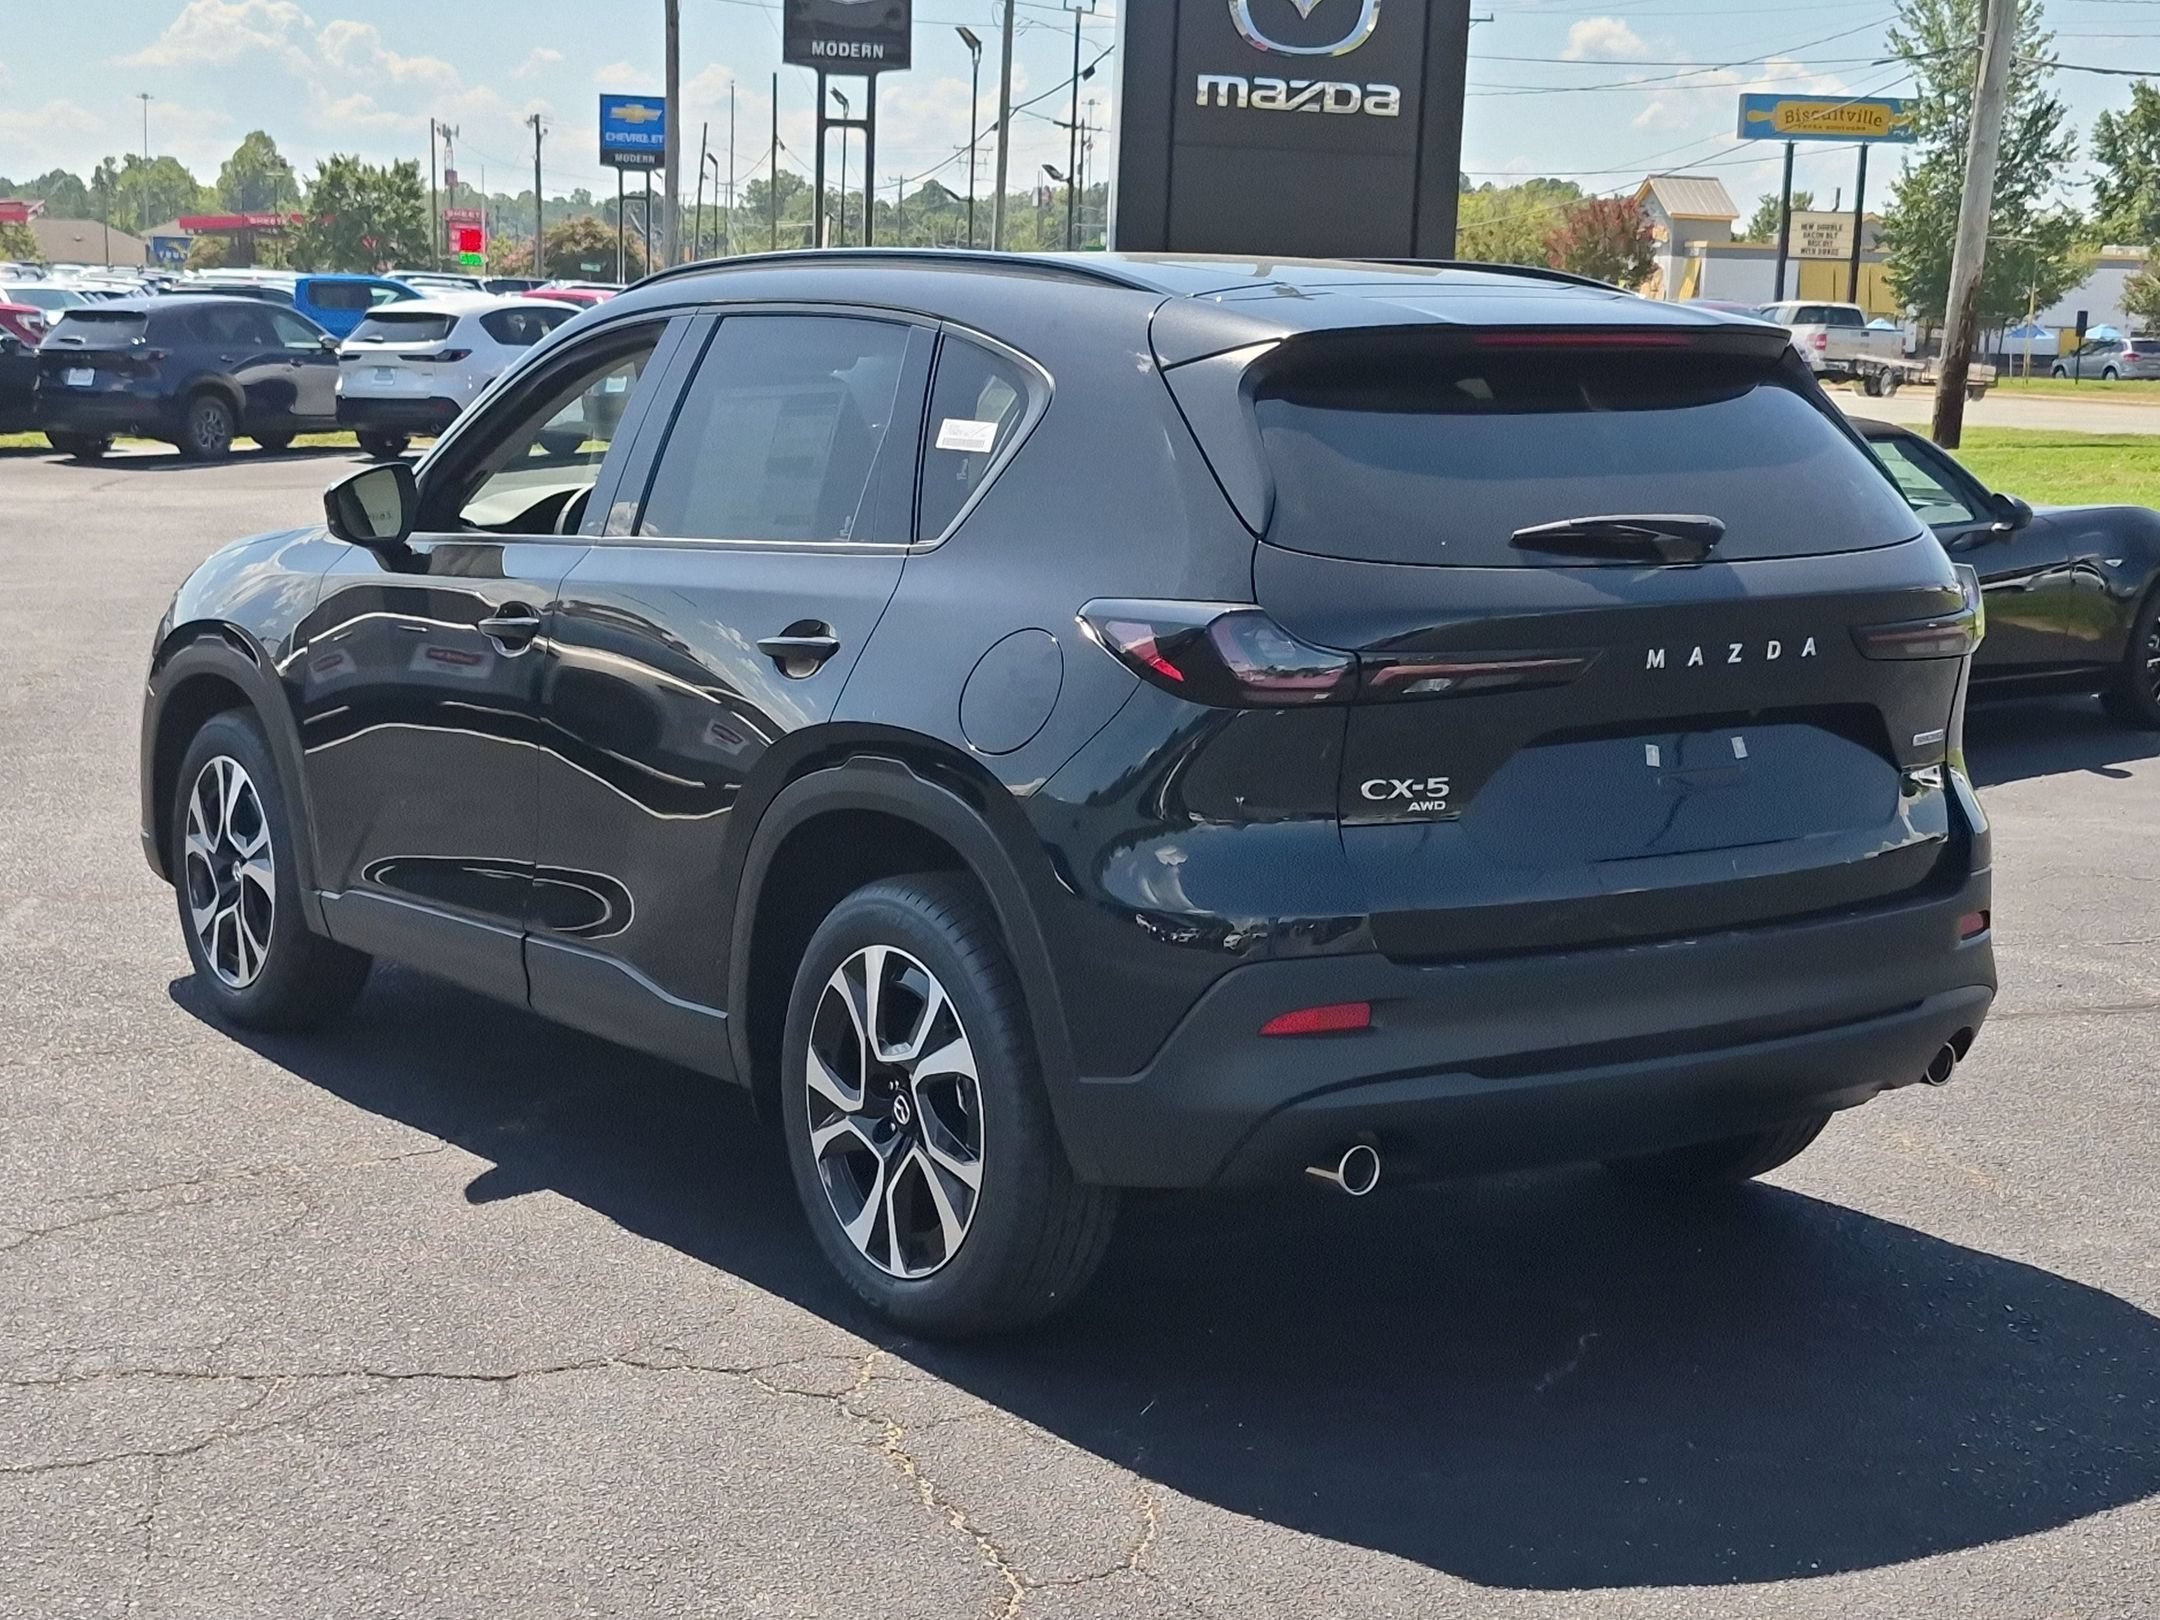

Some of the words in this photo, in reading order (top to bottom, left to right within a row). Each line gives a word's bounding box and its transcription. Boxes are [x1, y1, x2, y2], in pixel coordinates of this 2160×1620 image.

[811, 41, 884, 59] MODERN
[1196, 74, 1400, 116] mazda
[1785, 107, 1882, 127] Biscuitville
[605, 131, 664, 144] CHEVROLET
[614, 153, 656, 164] MODERN
[1646, 637, 1816, 670] MAZDA
[1360, 777, 1450, 800] CX-5
[1407, 801, 1446, 812] AWD
